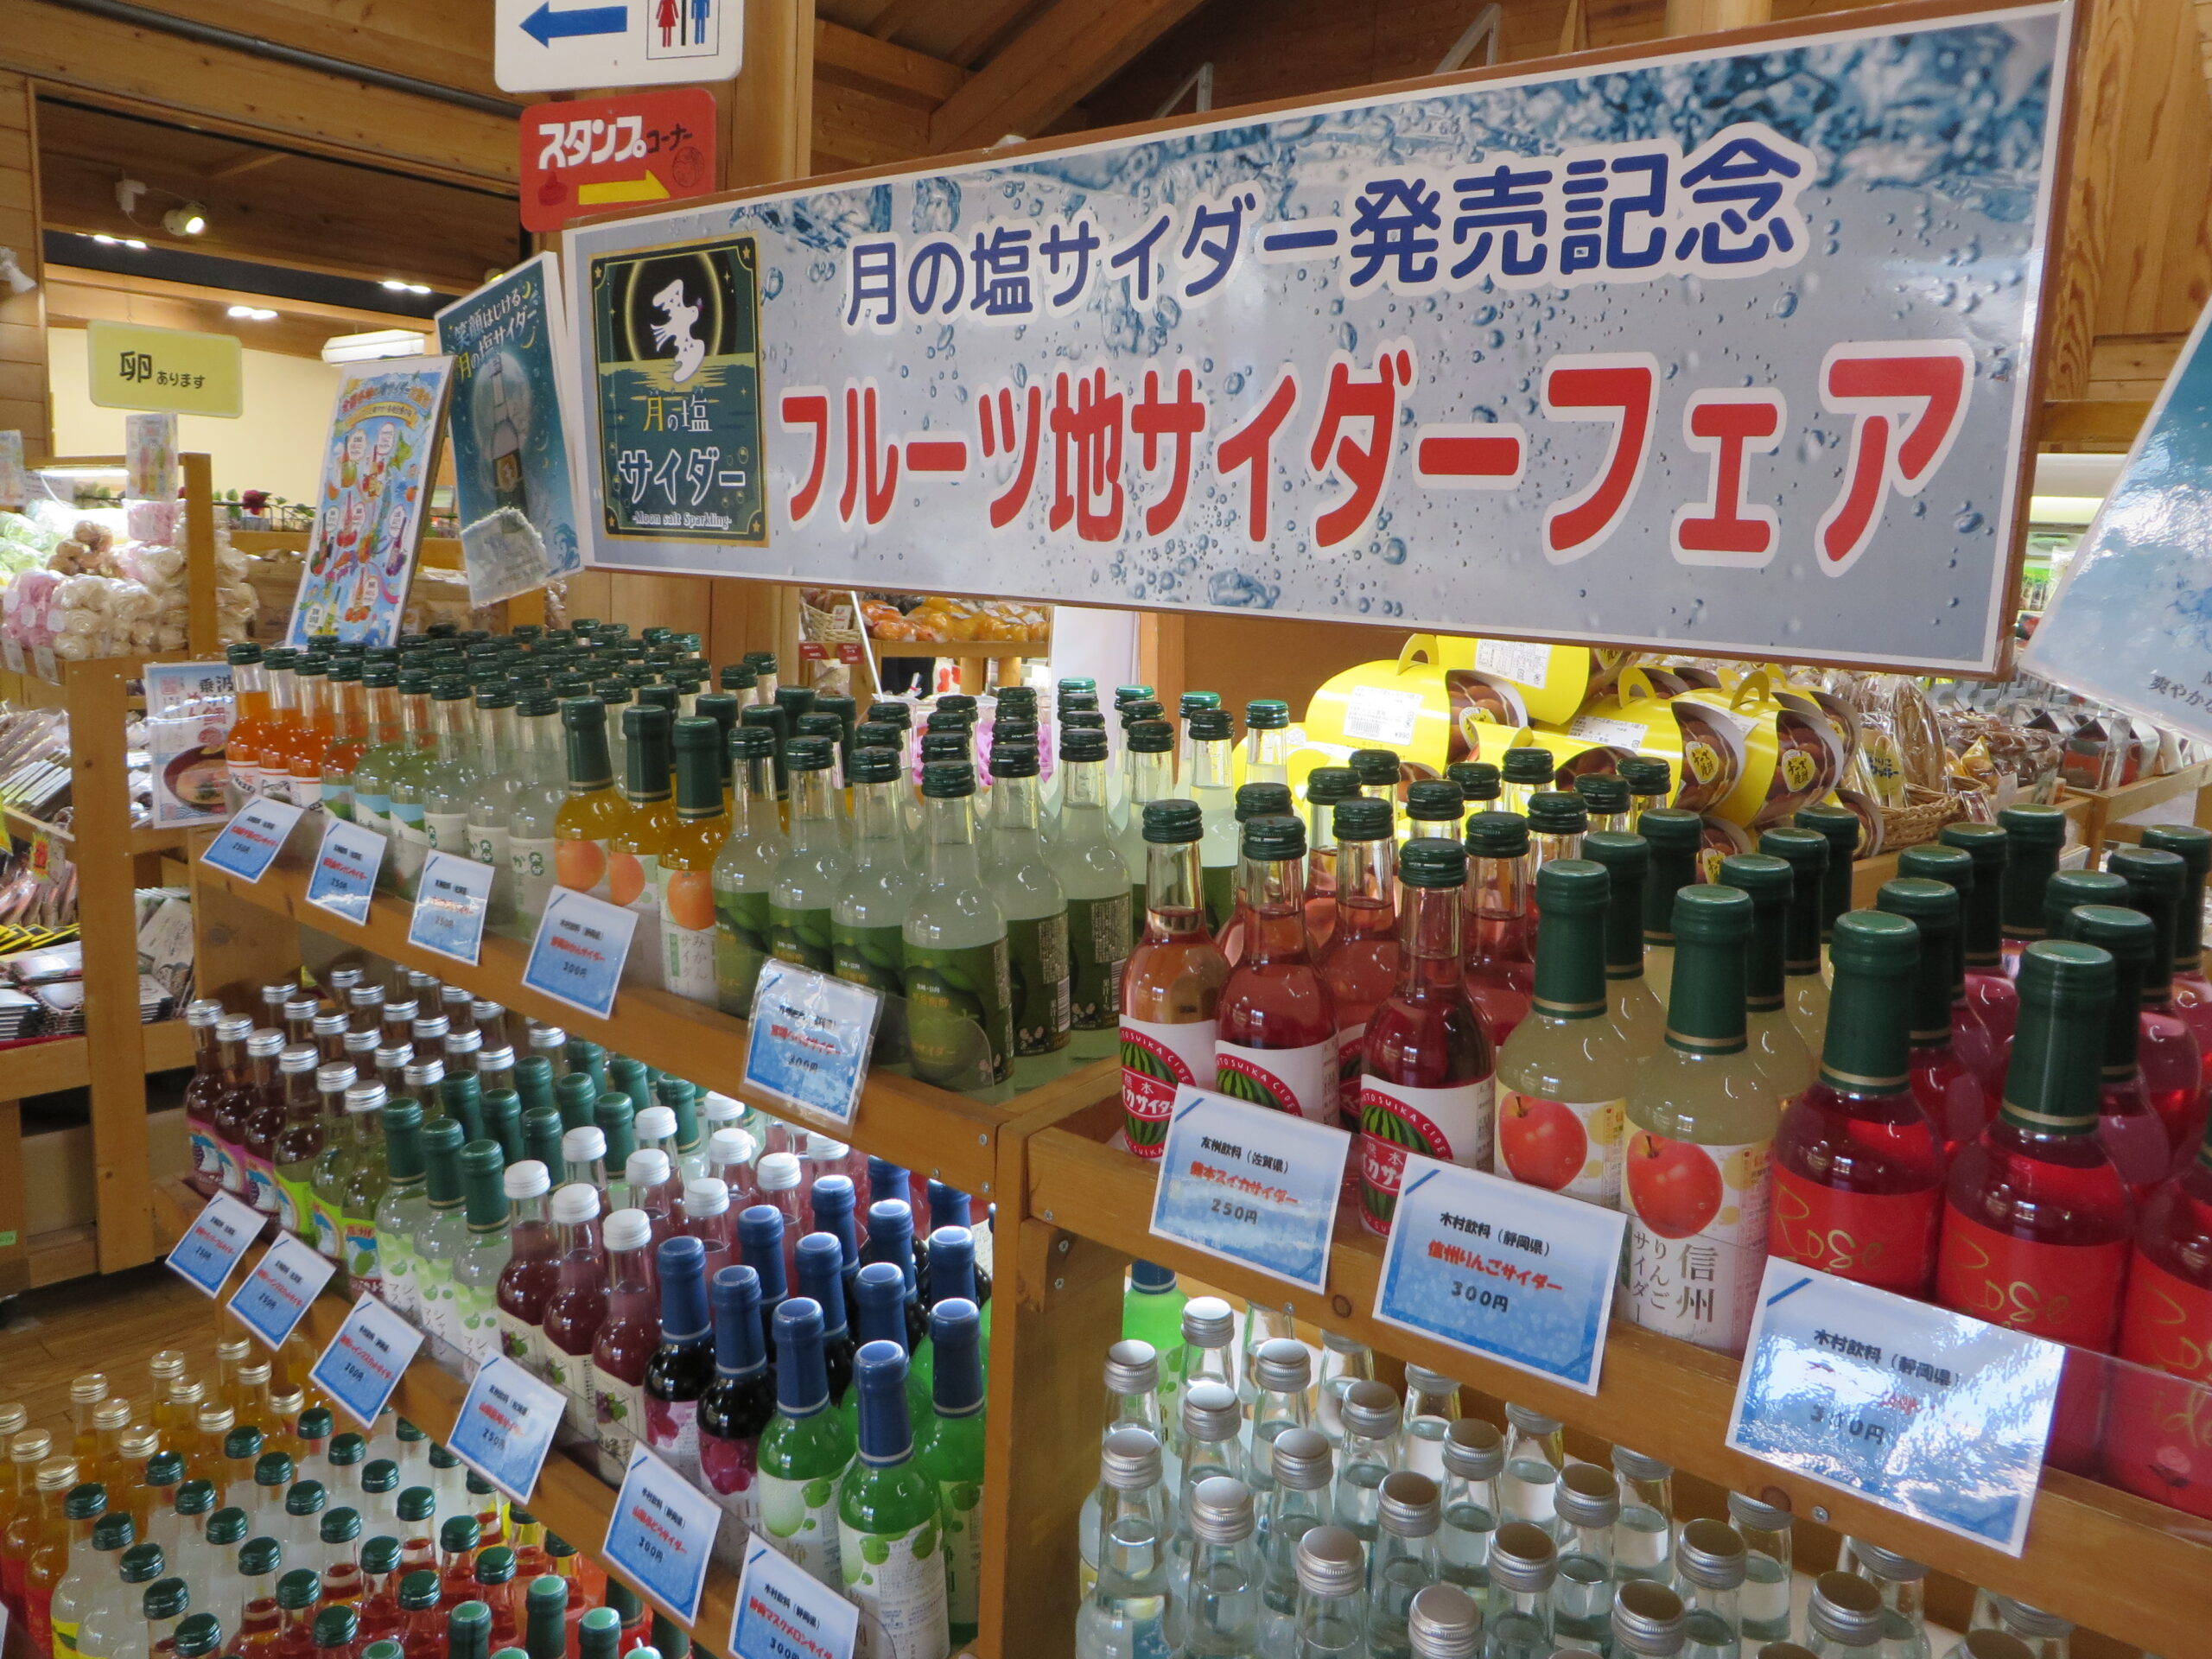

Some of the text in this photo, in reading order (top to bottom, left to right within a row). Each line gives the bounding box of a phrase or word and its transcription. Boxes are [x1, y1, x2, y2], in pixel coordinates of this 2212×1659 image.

[537, 115, 646, 170] スタンプ
[846, 135, 1803, 327] 月の塩サイダー発売記念
[454, 288, 522, 353] 笑顔はじける
[118, 350, 207, 390] 卵 あります
[642, 394, 713, 432] 月の塩
[617, 447, 747, 506] サイダー
[780, 346, 1966, 563] フルーツ地サイダーフェア
[1130, 1033, 1163, 1056] SUIKA
[1167, 1054, 1190, 1084] CIDE
[1231, 1058, 1268, 1083] SUIKA
[1378, 1095, 1418, 1123] SUIKA
[1191, 1160, 1300, 1205] 熊本スイカサイダー
[1211, 1198, 1258, 1225] 250円
[1440, 1211, 1551, 1258] 木村飲料（静岡県）
[1427, 1240, 1563, 1293] 信州りんごサイダー
[1632, 1230, 1650, 1324] サイダー
[1649, 1237, 1670, 1311] りんご
[1676, 1243, 1719, 1323] 信州
[1450, 1281, 1510, 1313] 300円
[1813, 1329, 1961, 1388] 木村飲料（静岡県）
[638, 1535, 664, 1564] 300円
